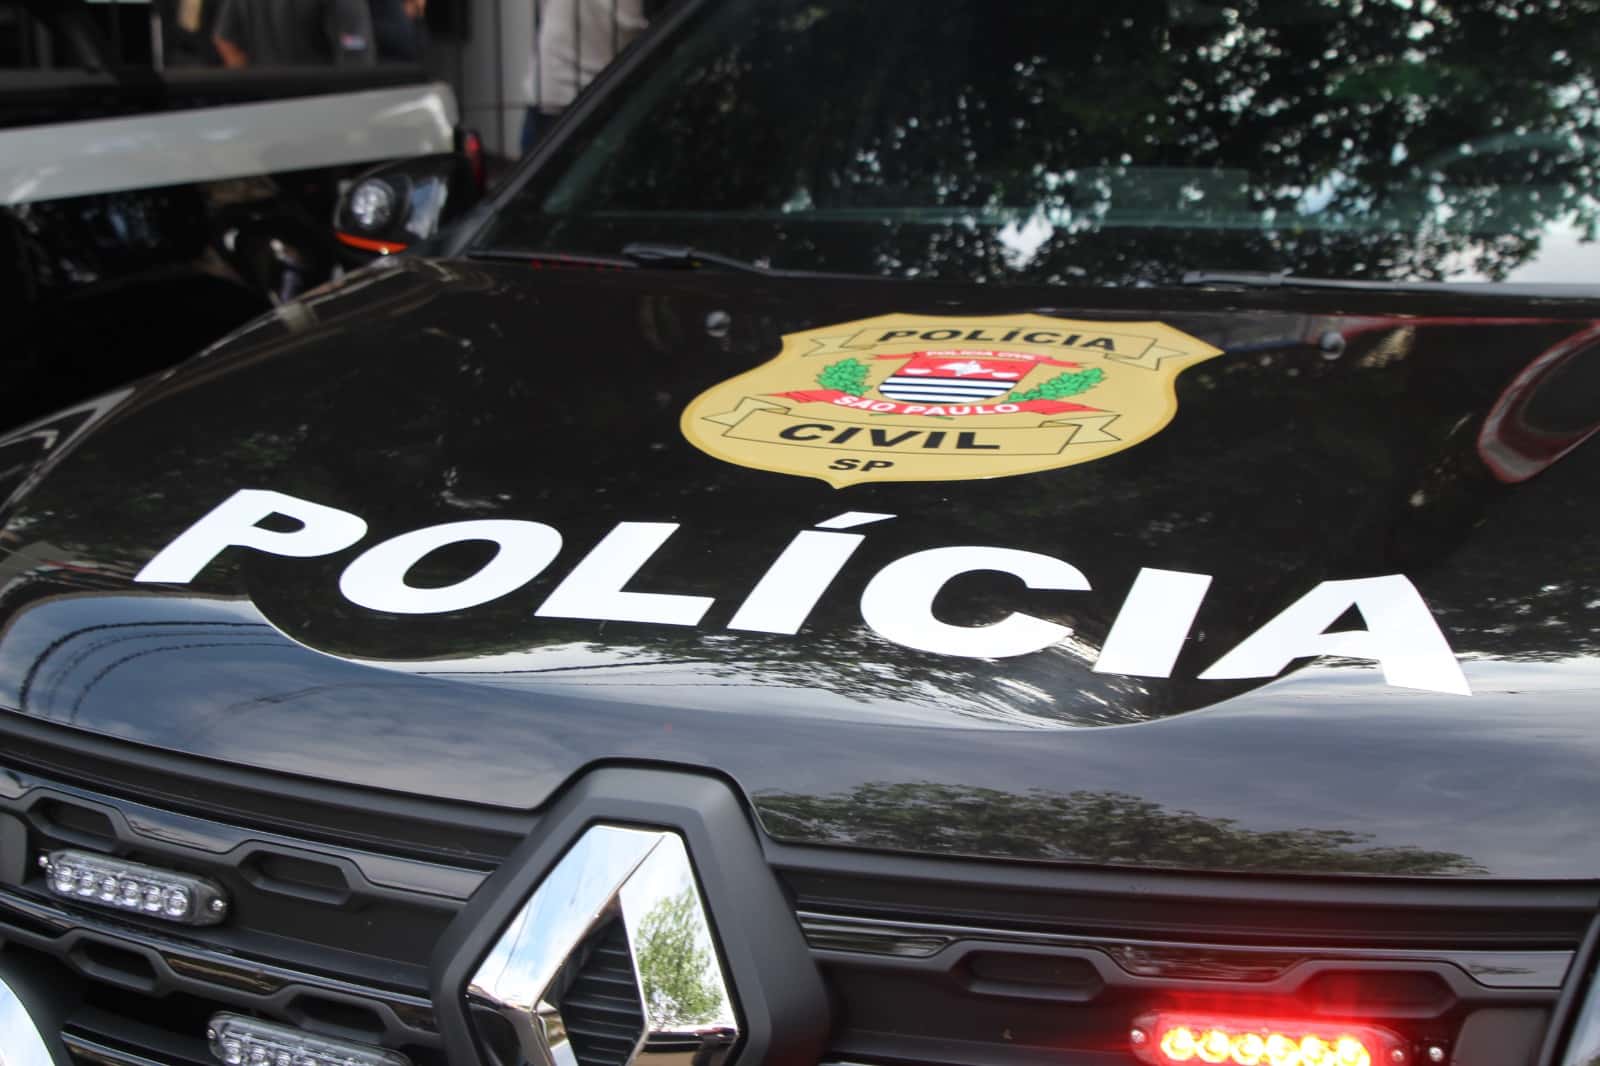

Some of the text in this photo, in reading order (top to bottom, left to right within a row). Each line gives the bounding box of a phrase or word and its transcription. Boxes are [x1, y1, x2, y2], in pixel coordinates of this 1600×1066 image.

[878, 327, 1116, 352] POLÍCIA
[902, 403, 1020, 416] PAULO
[779, 423, 1001, 450] CIVIL
[827, 458, 895, 473] SP
[134, 488, 1472, 697] POLÍCIA
